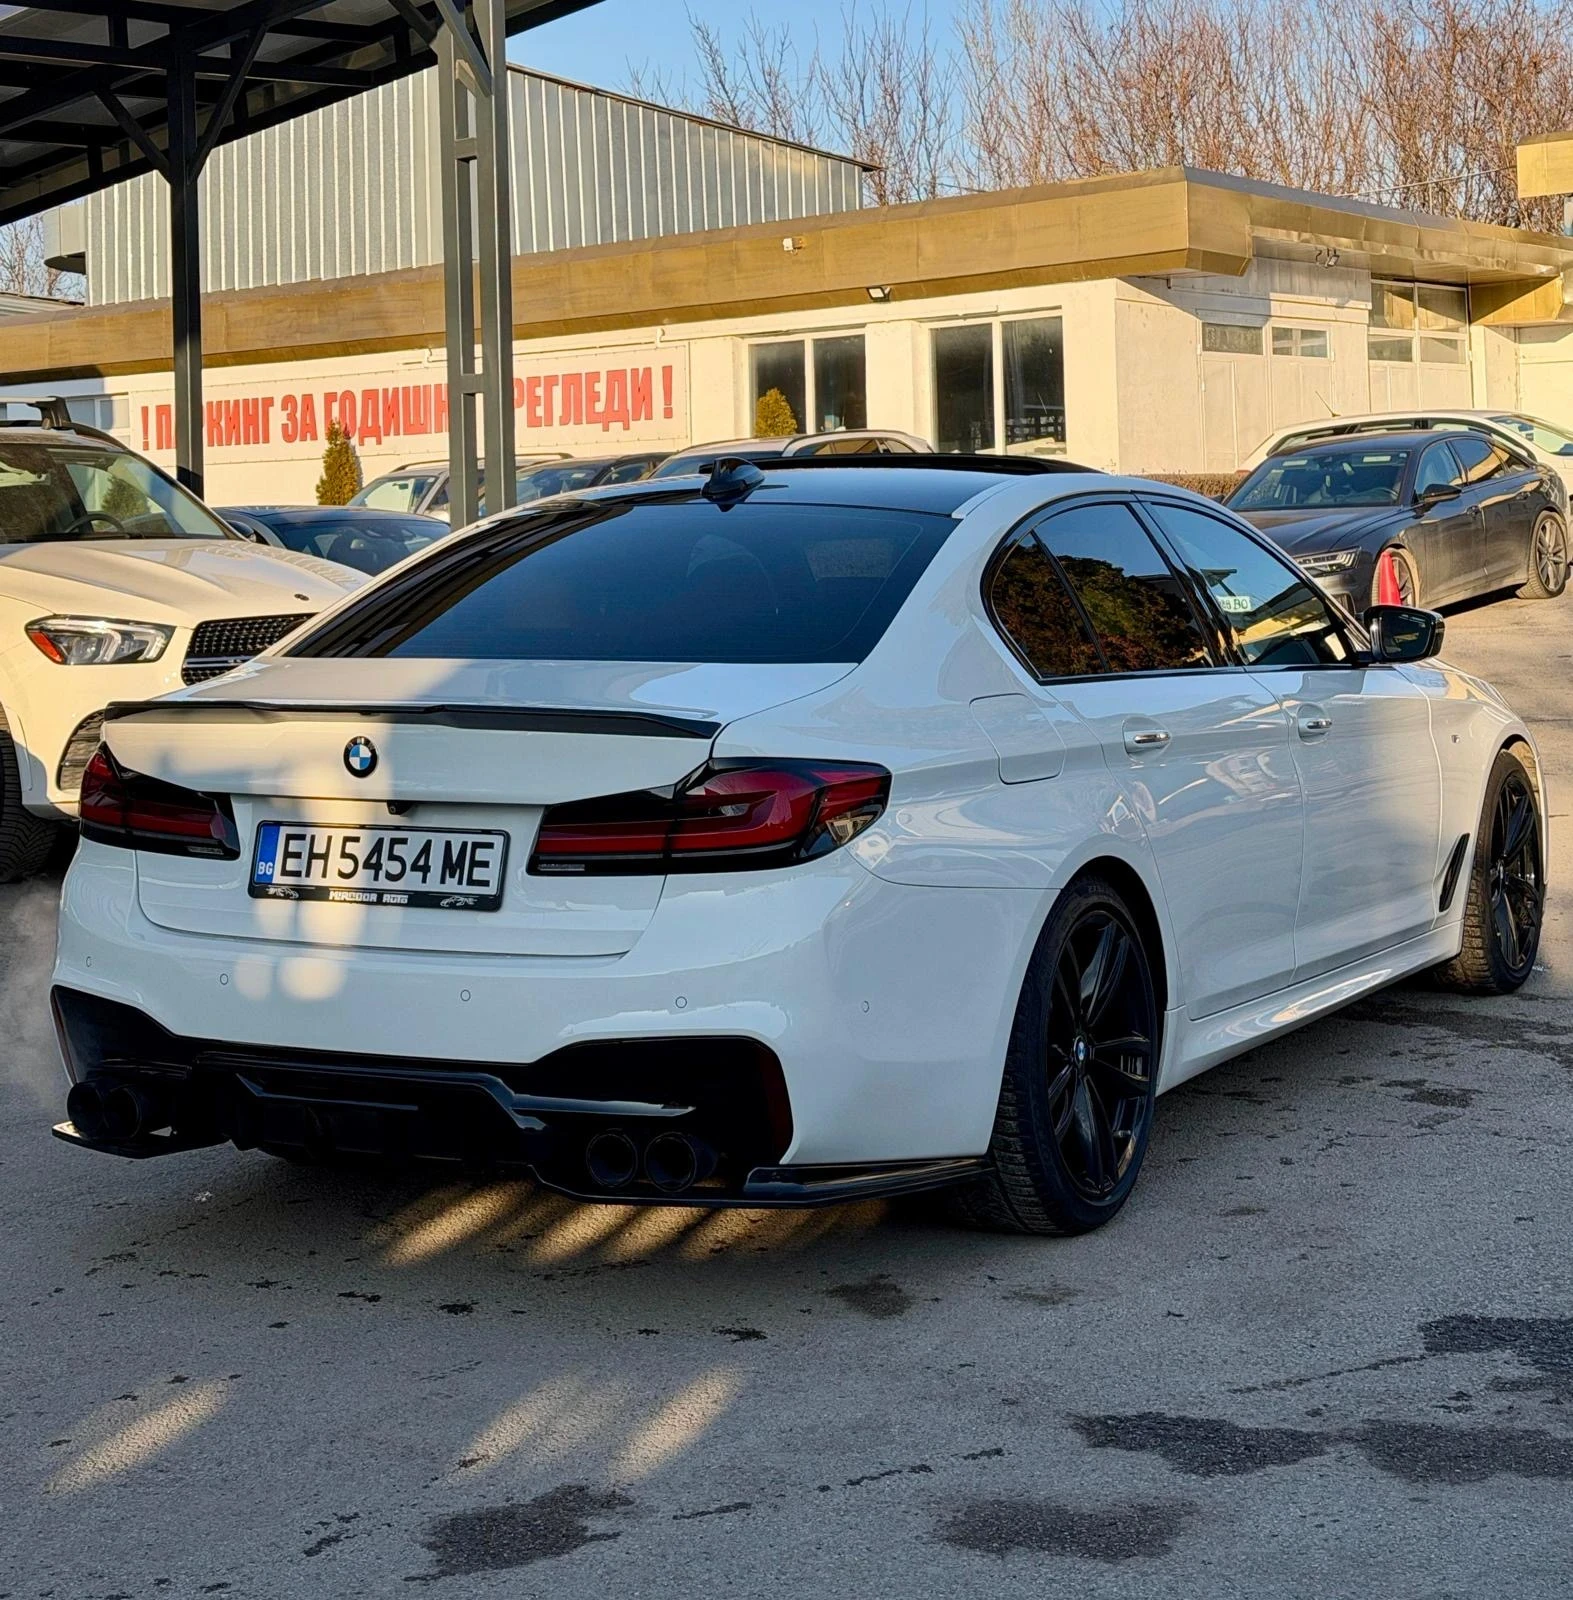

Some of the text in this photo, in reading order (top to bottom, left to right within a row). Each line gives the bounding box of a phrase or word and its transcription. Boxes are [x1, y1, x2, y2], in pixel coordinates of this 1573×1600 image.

[141, 365, 673, 451] ! ПКИНГ ЗА ГОДИШН РЕГЛЕДИ !
[258, 861, 273, 876] BG
